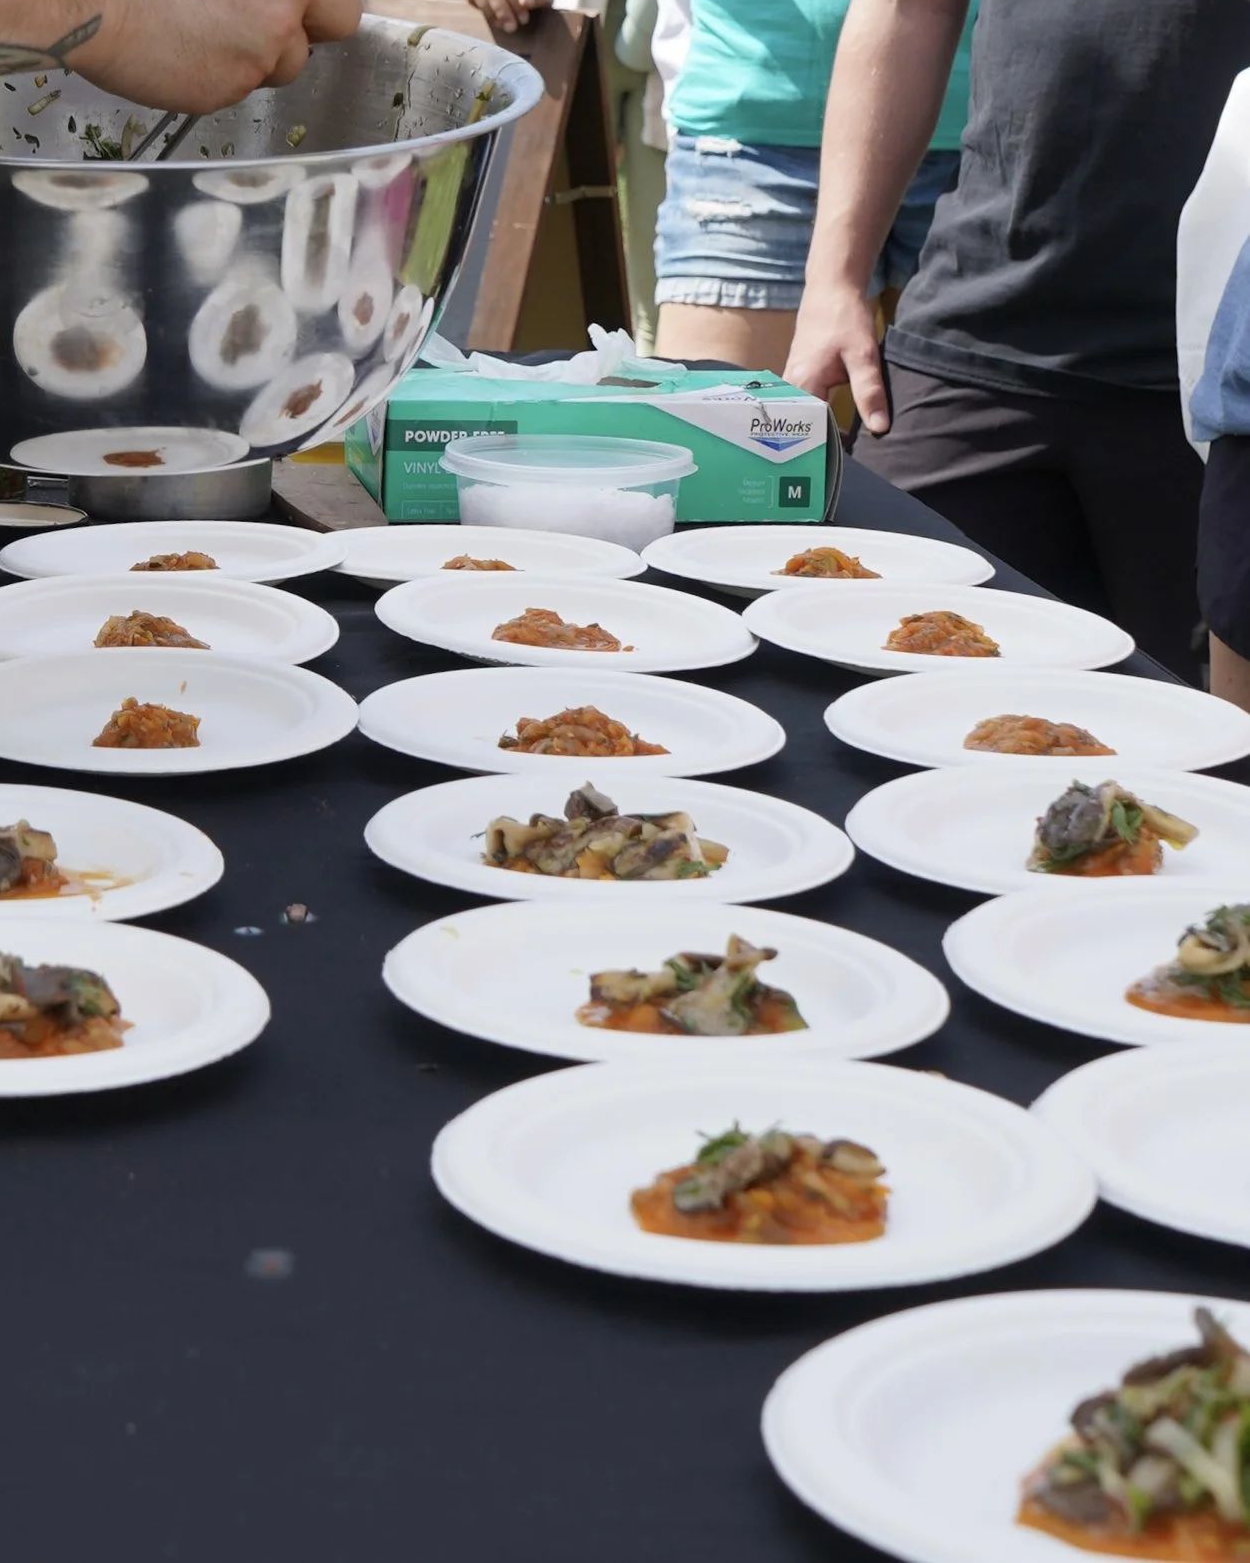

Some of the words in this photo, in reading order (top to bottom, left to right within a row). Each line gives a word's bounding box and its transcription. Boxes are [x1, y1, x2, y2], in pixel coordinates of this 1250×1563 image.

[750, 418, 811, 433] ProWorks
[403, 462, 441, 474] VINYL
[787, 485, 802, 499] M
